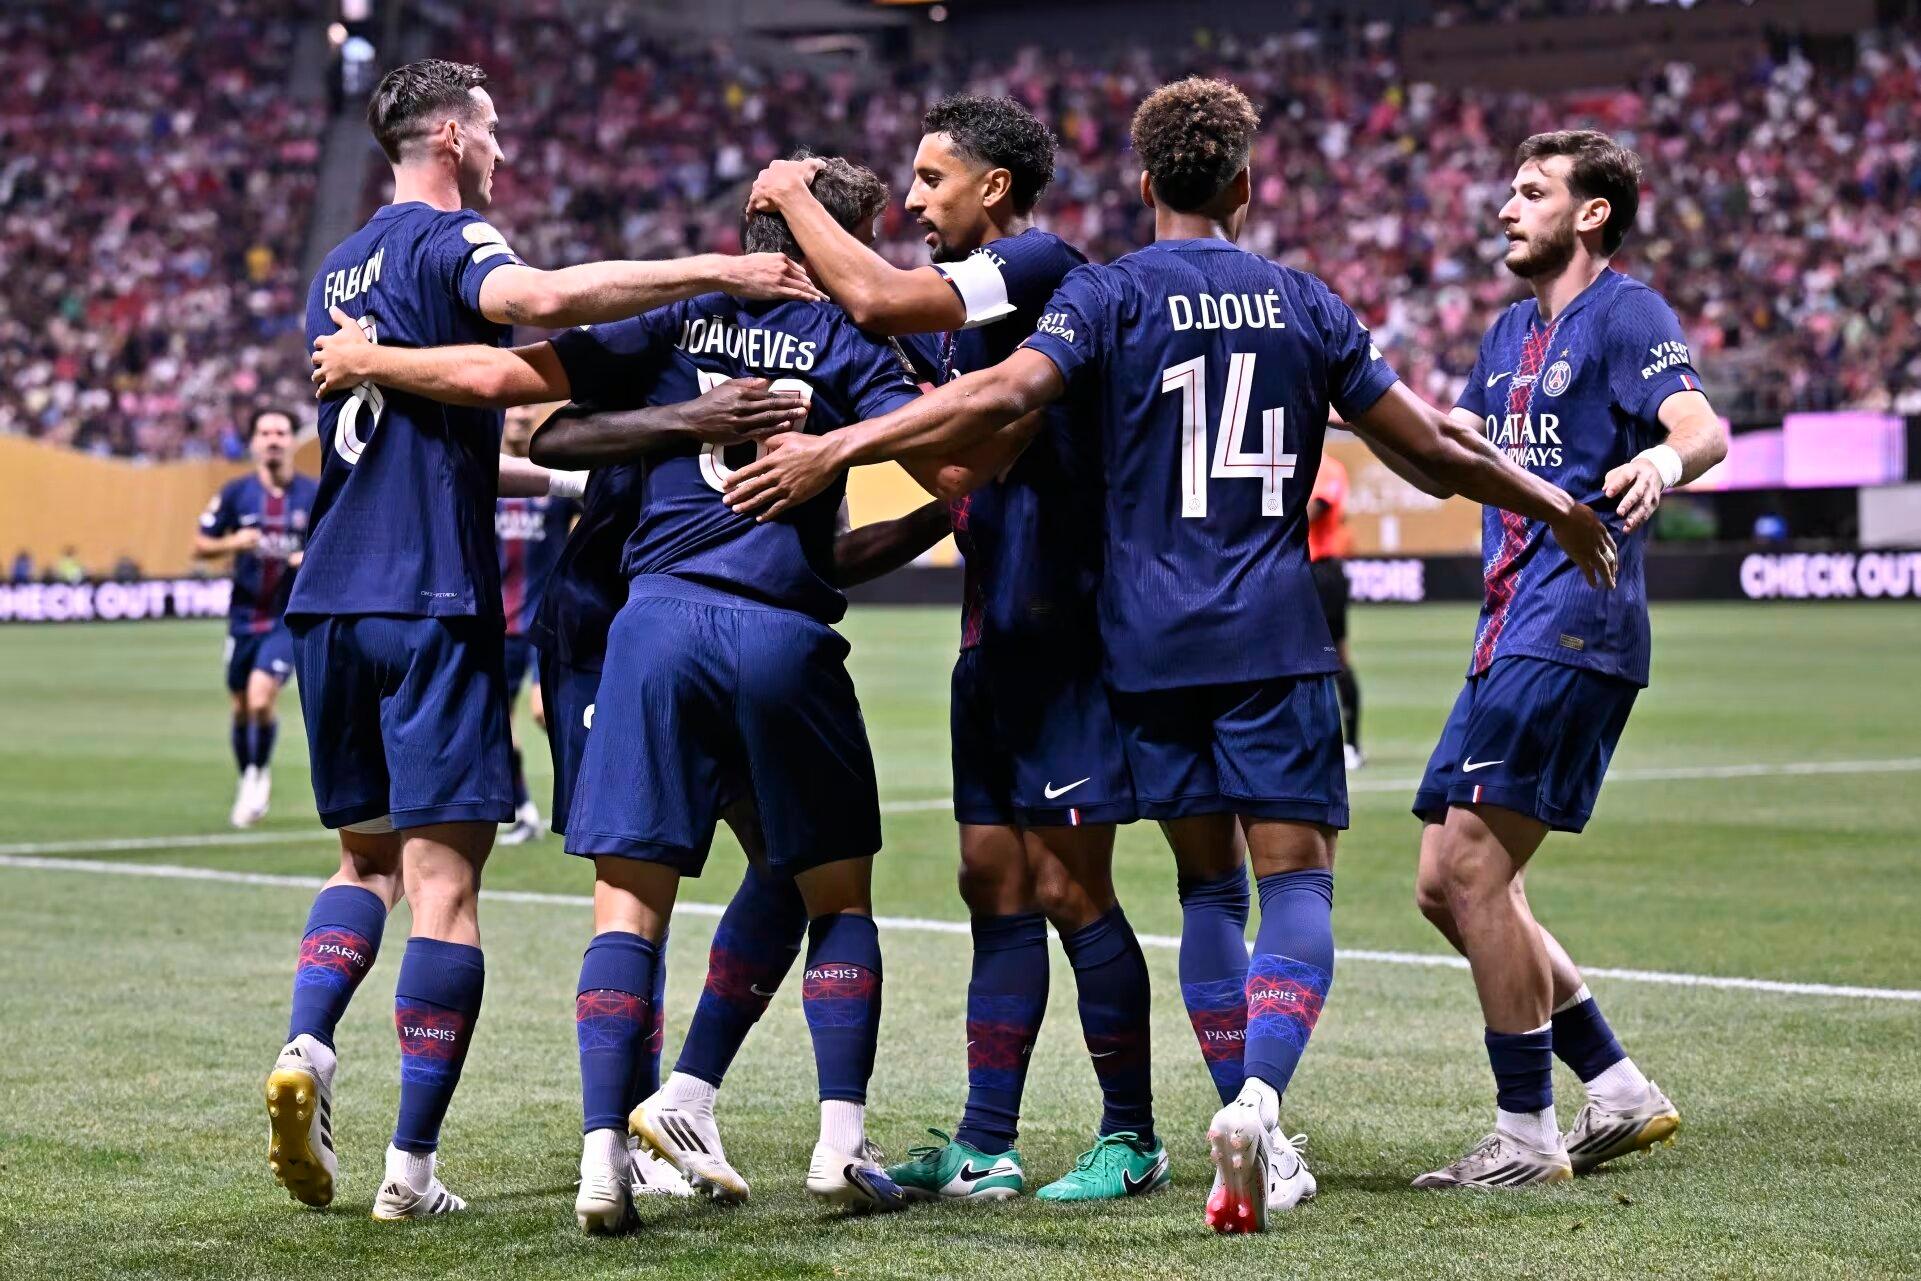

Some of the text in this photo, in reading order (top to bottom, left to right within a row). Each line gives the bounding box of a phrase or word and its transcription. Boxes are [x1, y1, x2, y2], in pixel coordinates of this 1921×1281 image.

[1168, 288, 1286, 331] D.DOUÉ
[1641, 353, 1690, 379] RWAN
[1161, 352, 1298, 518] 14
[1486, 413, 1563, 445] QATAR
[1740, 552, 1857, 598] CHECK
[0, 581, 94, 619] HECK
[317, 943, 368, 968] PARIS
[805, 968, 859, 981] PARIS
[1250, 989, 1298, 1005] PARIS
[403, 1026, 457, 1042] PARIS
